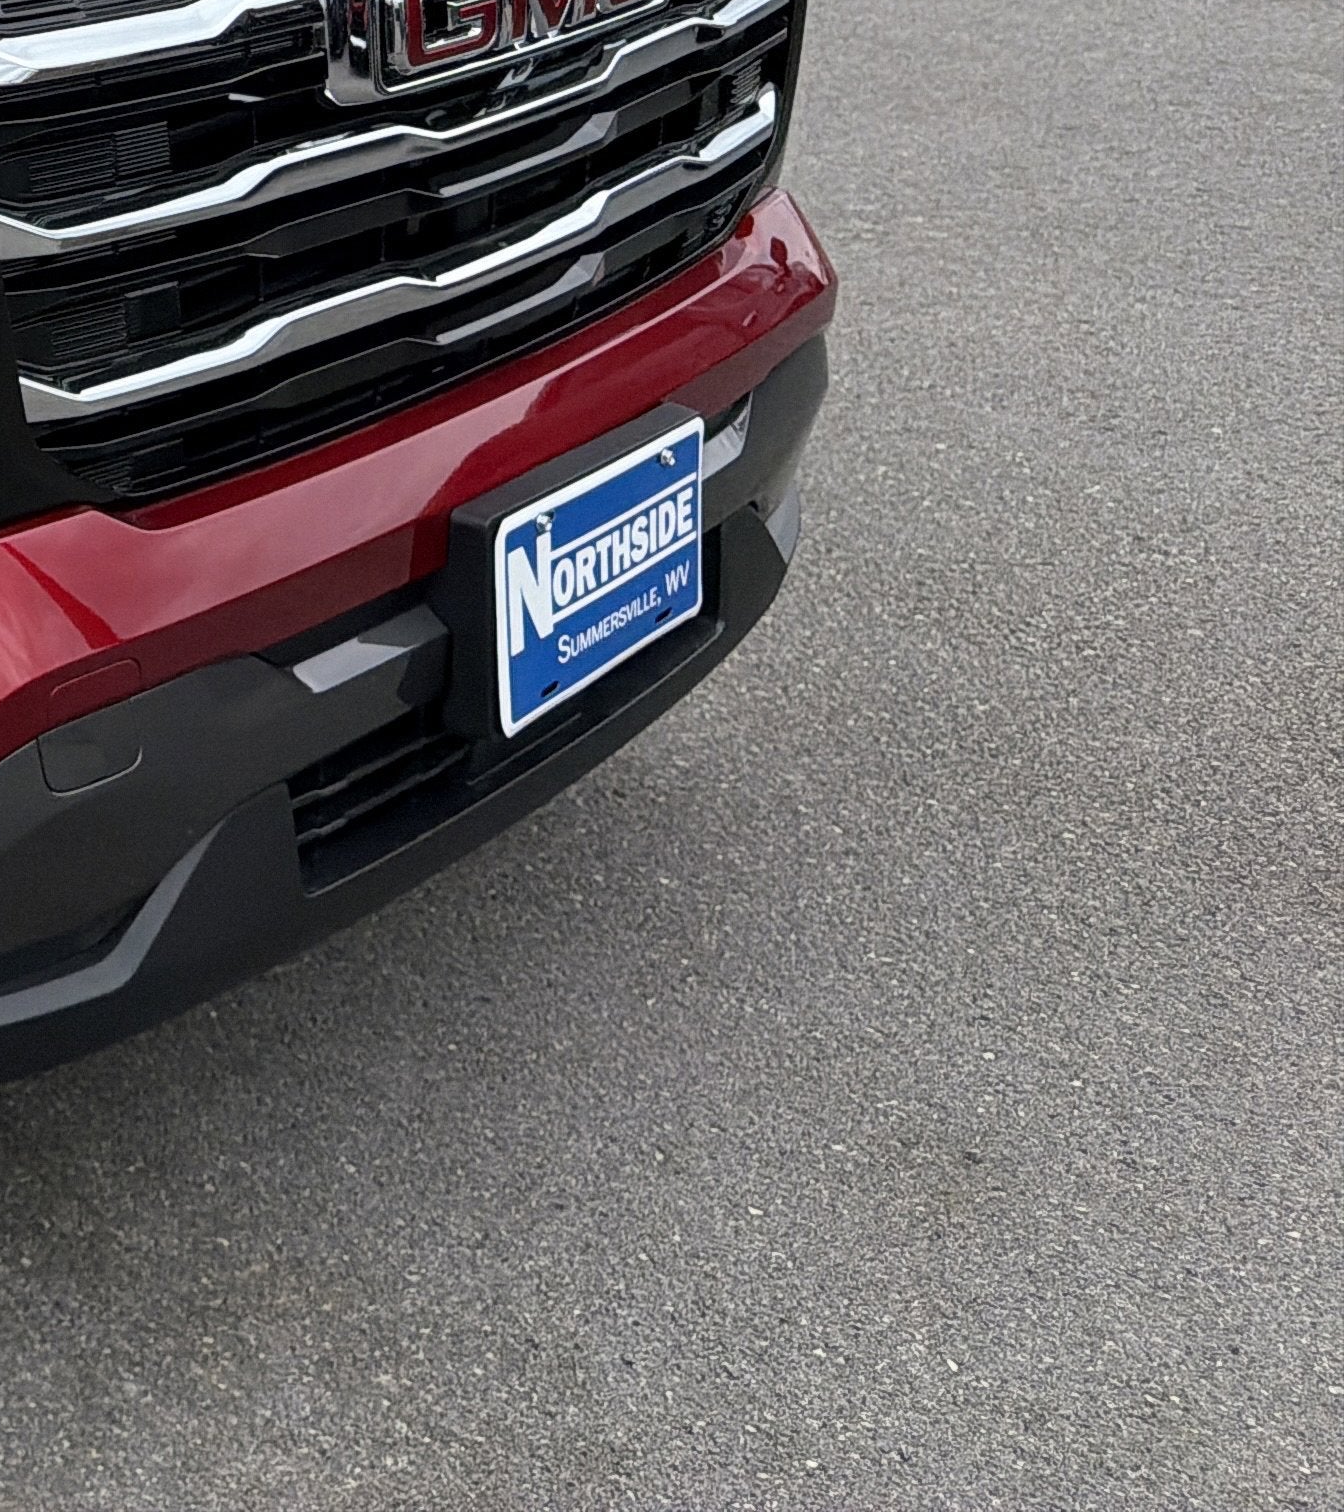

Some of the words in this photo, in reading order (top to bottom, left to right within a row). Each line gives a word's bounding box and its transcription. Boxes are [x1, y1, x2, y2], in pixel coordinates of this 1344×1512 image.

[507, 486, 695, 657] NORTHSIDE
[557, 585, 662, 665] SUMMERSVILLE,
[664, 559, 691, 597] WV
